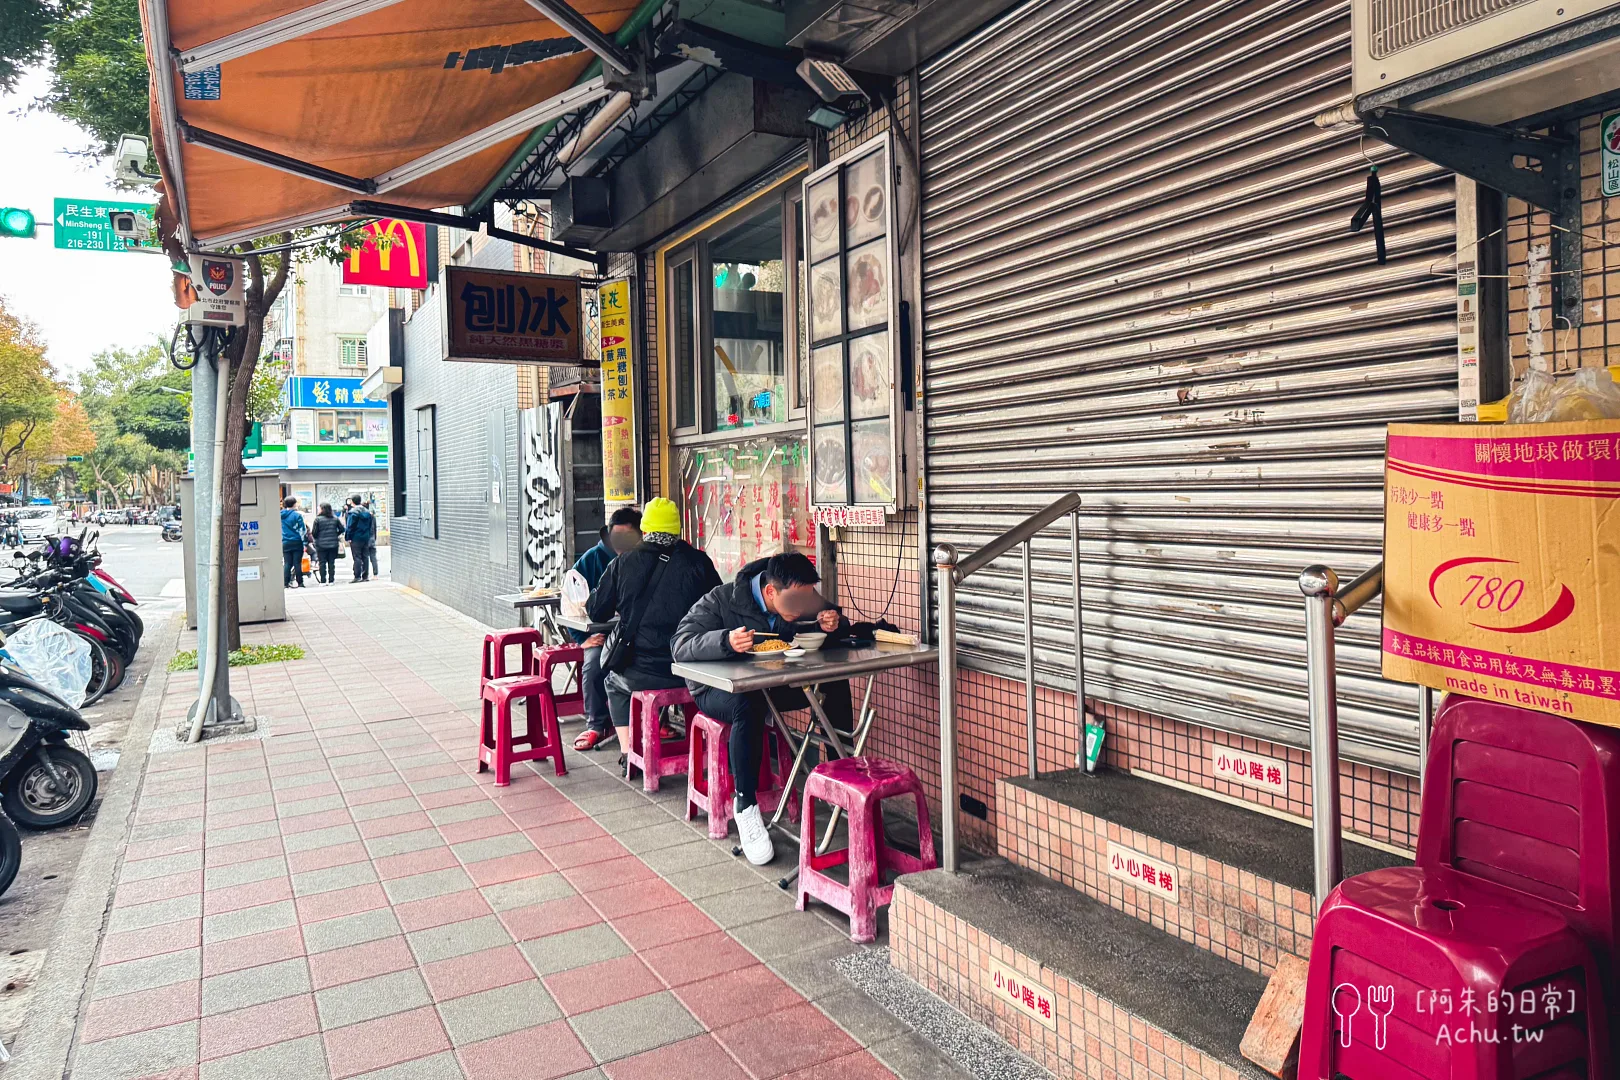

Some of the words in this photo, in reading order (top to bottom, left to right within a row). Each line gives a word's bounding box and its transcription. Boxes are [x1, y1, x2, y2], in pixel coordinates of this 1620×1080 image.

[1608, 158, 1619, 191] 松山區
[65, 220, 102, 230] MinSheng
[66, 204, 148, 218] 民生東段
[67, 239, 104, 249] 216-230
[83, 230, 102, 240] -191
[201, 297, 241, 306] 北市政府警察局
[209, 282, 227, 291] POLICE
[461, 281, 571, 336] 刨冰
[606, 349, 616, 401] 薏仁茶
[616, 347, 629, 400] 黑糖刨冰
[1408, 511, 1475, 537] 健康多一點
[1460, 574, 1525, 612] 780
[1391, 635, 1620, 696] 本產品採用食品用紙及無毒油墨
[1446, 675, 1488, 695] made
[1493, 683, 1509, 700] in
[1514, 688, 1573, 714] taiwan
[1217, 754, 1282, 785] 小心階梯
[1112, 852, 1173, 892] 小心階梯
[994, 969, 1051, 1019] 小心階梯
